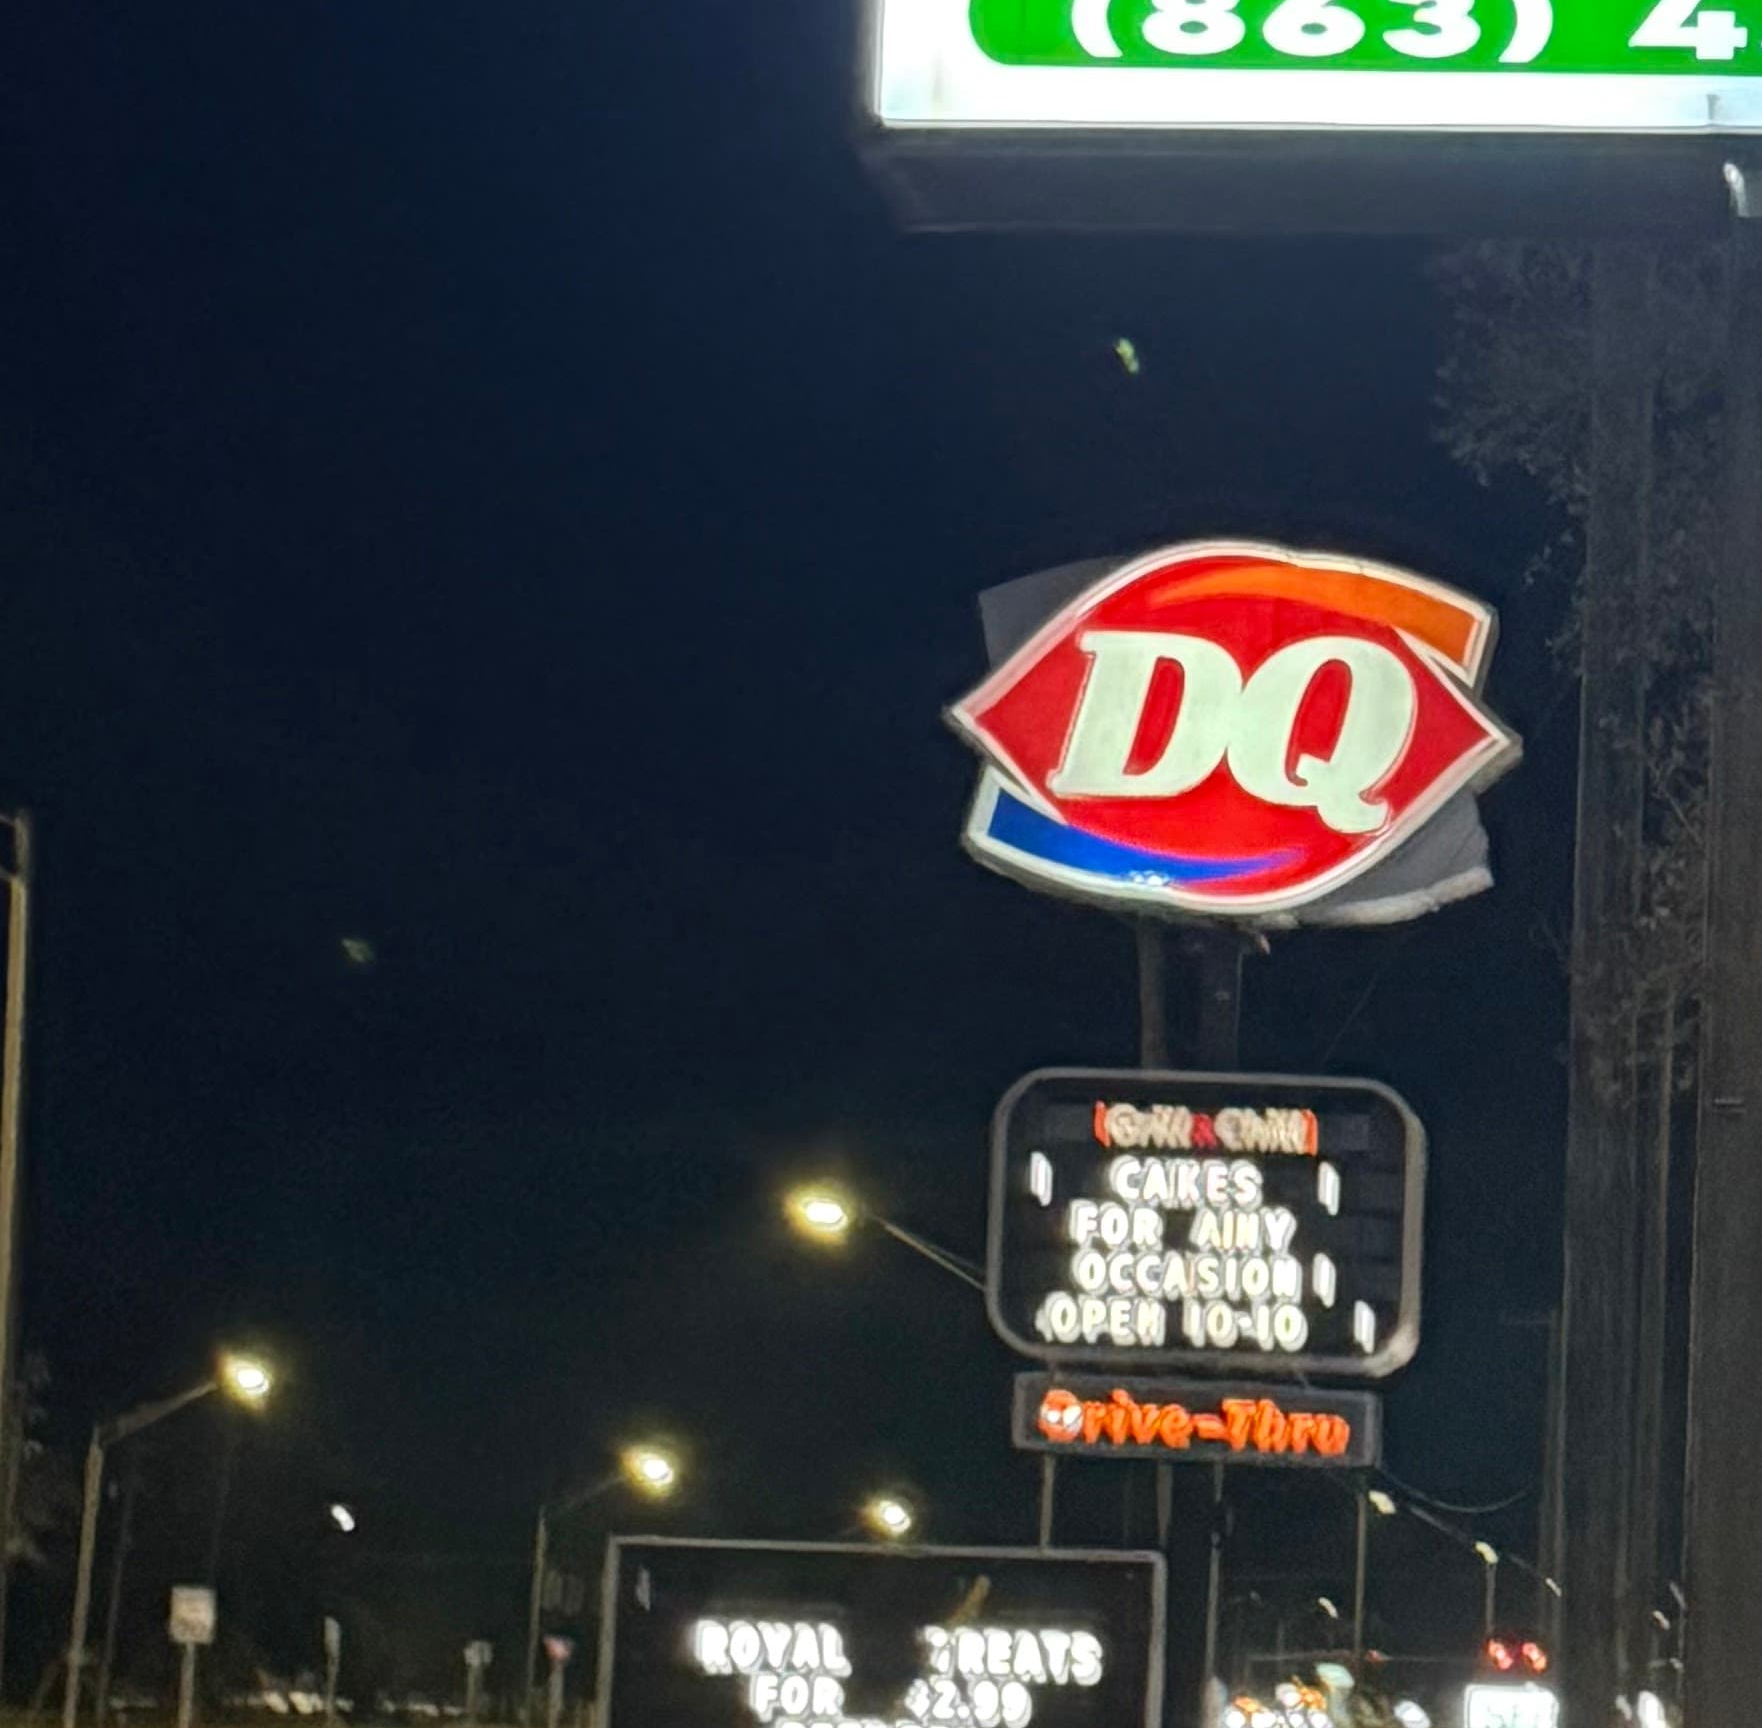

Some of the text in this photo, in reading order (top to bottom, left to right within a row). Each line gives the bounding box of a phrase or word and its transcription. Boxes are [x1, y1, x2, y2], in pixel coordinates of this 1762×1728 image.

[1047, 630, 1417, 834] DQ
[1109, 1156, 1264, 1209] CAKES
[1068, 1200, 1164, 1248] FOR
[1072, 1250, 1303, 1300] OCCASION
[1044, 1292, 1308, 1351] OPEN 10-10
[1038, 1388, 1350, 1457] Drive-Thru
[694, 1619, 1104, 1686] ROYAL TREATS
[749, 1672, 844, 1722] FOR
